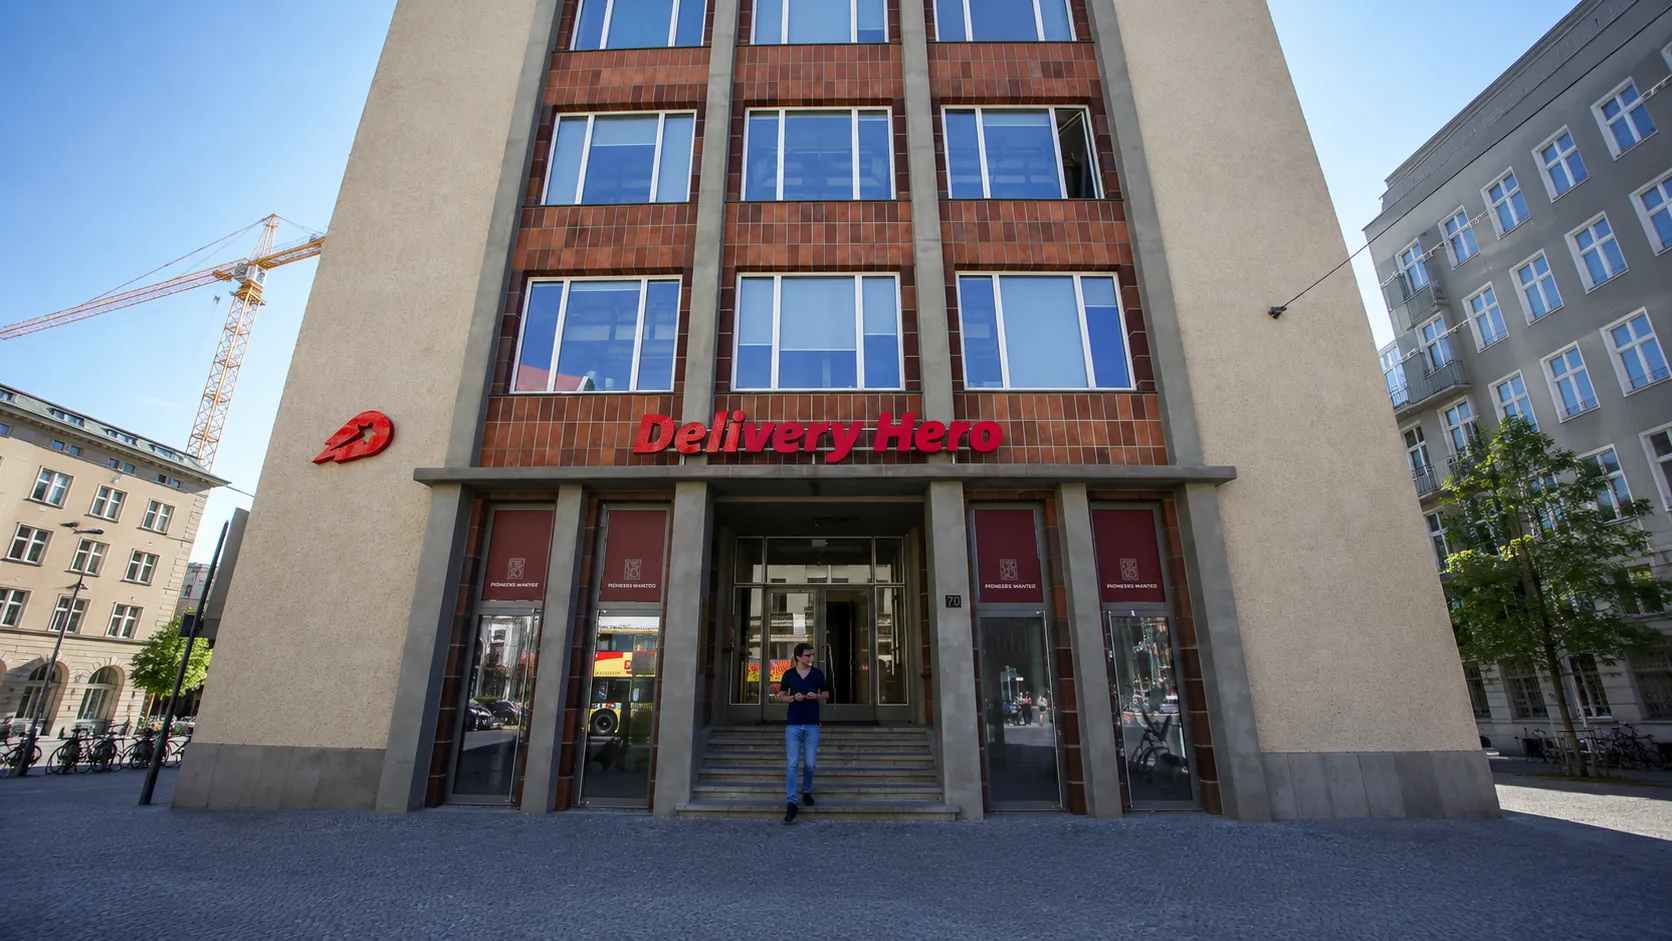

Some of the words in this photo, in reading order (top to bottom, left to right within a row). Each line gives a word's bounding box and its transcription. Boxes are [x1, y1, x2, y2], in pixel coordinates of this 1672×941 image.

[633, 410, 864, 463] Delivery
[872, 411, 1004, 453] Hero
[947, 596, 961, 606] 70
